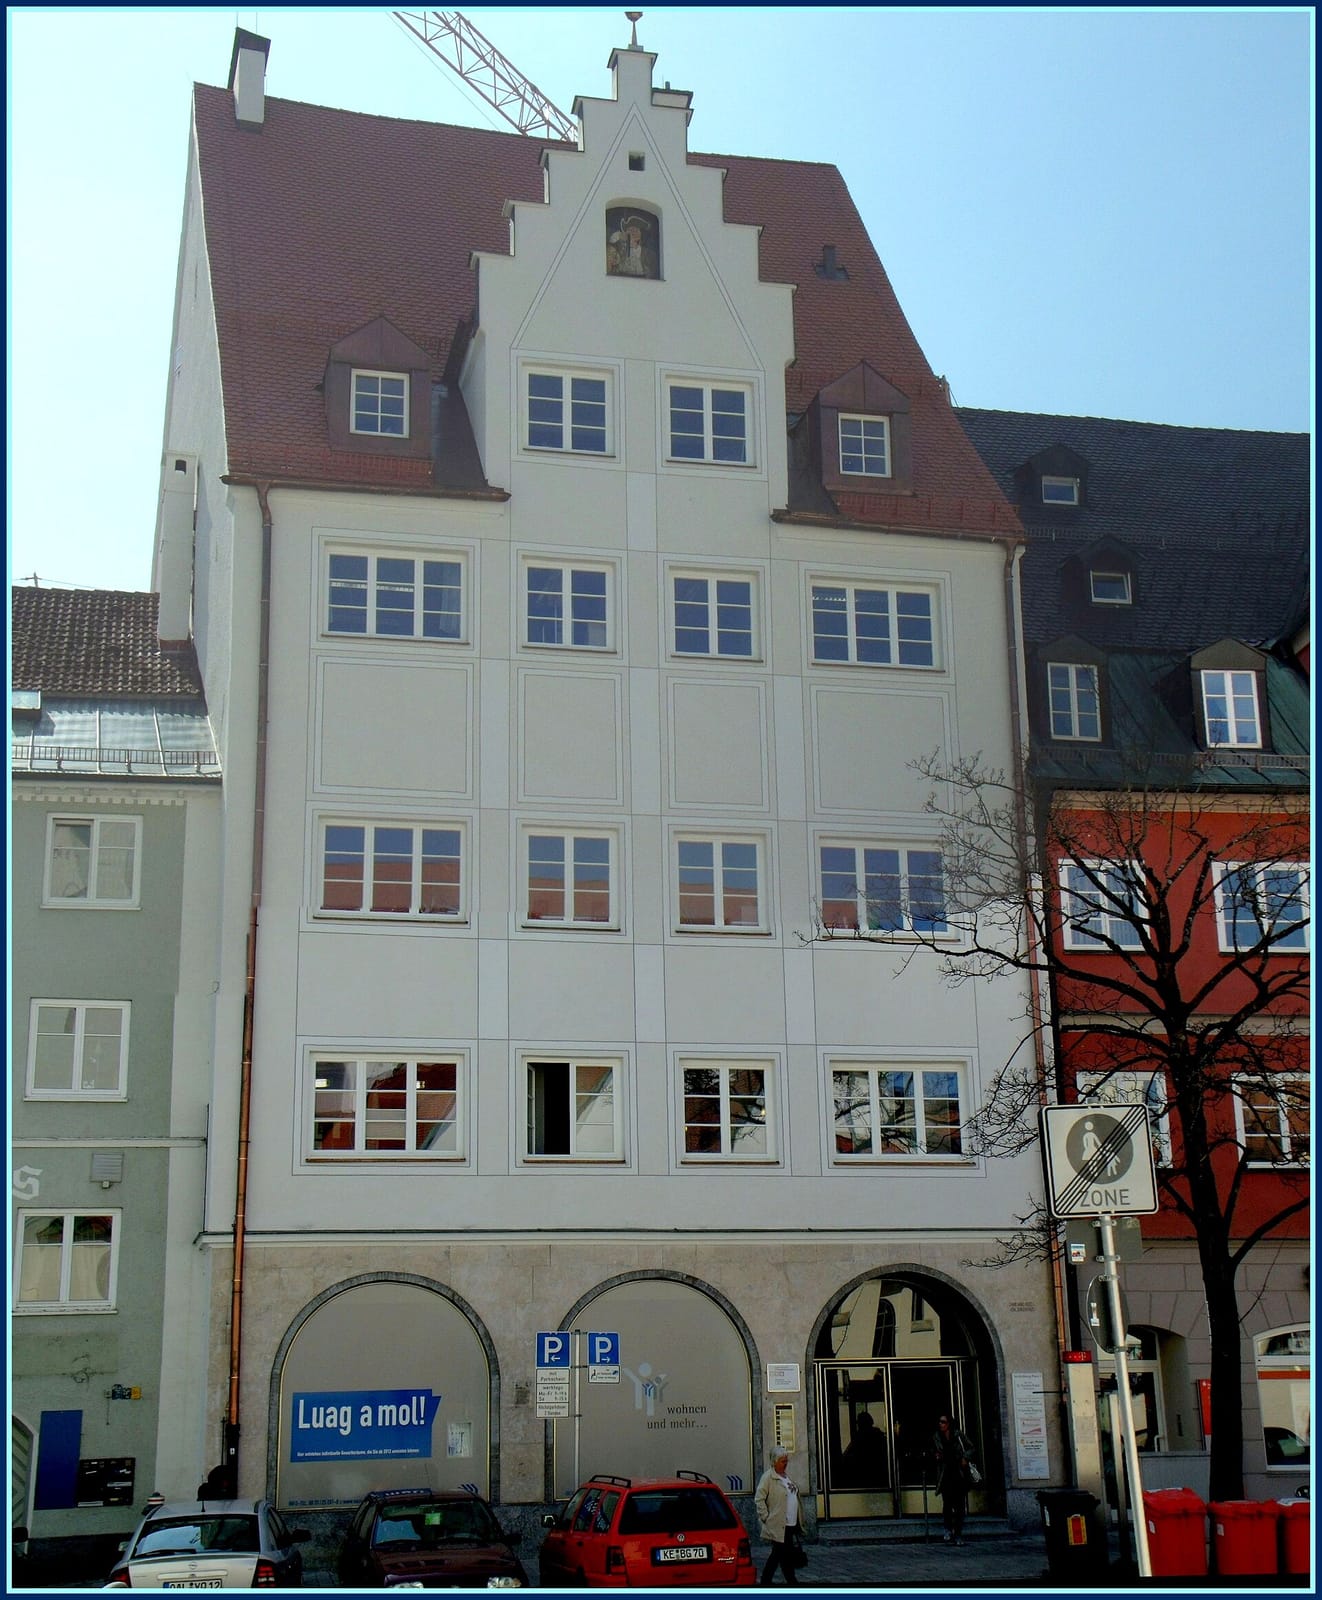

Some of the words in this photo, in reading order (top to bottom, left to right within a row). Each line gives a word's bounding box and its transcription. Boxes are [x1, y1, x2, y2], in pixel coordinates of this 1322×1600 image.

[1080, 1189, 1130, 1207] ZONE
[544, 1337, 562, 1363] P
[596, 1337, 612, 1362] P
[298, 1400, 352, 1436] Luag
[360, 1405, 372, 1426] a
[377, 1396, 426, 1426] mol!
[668, 1404, 707, 1414] wohnen
[648, 1419, 666, 1429] und
[670, 1418, 707, 1428] mehr...
[664, 1550, 675, 1559] KE
[680, 1549, 691, 1558] BG
[693, 1549, 704, 1557] 70
